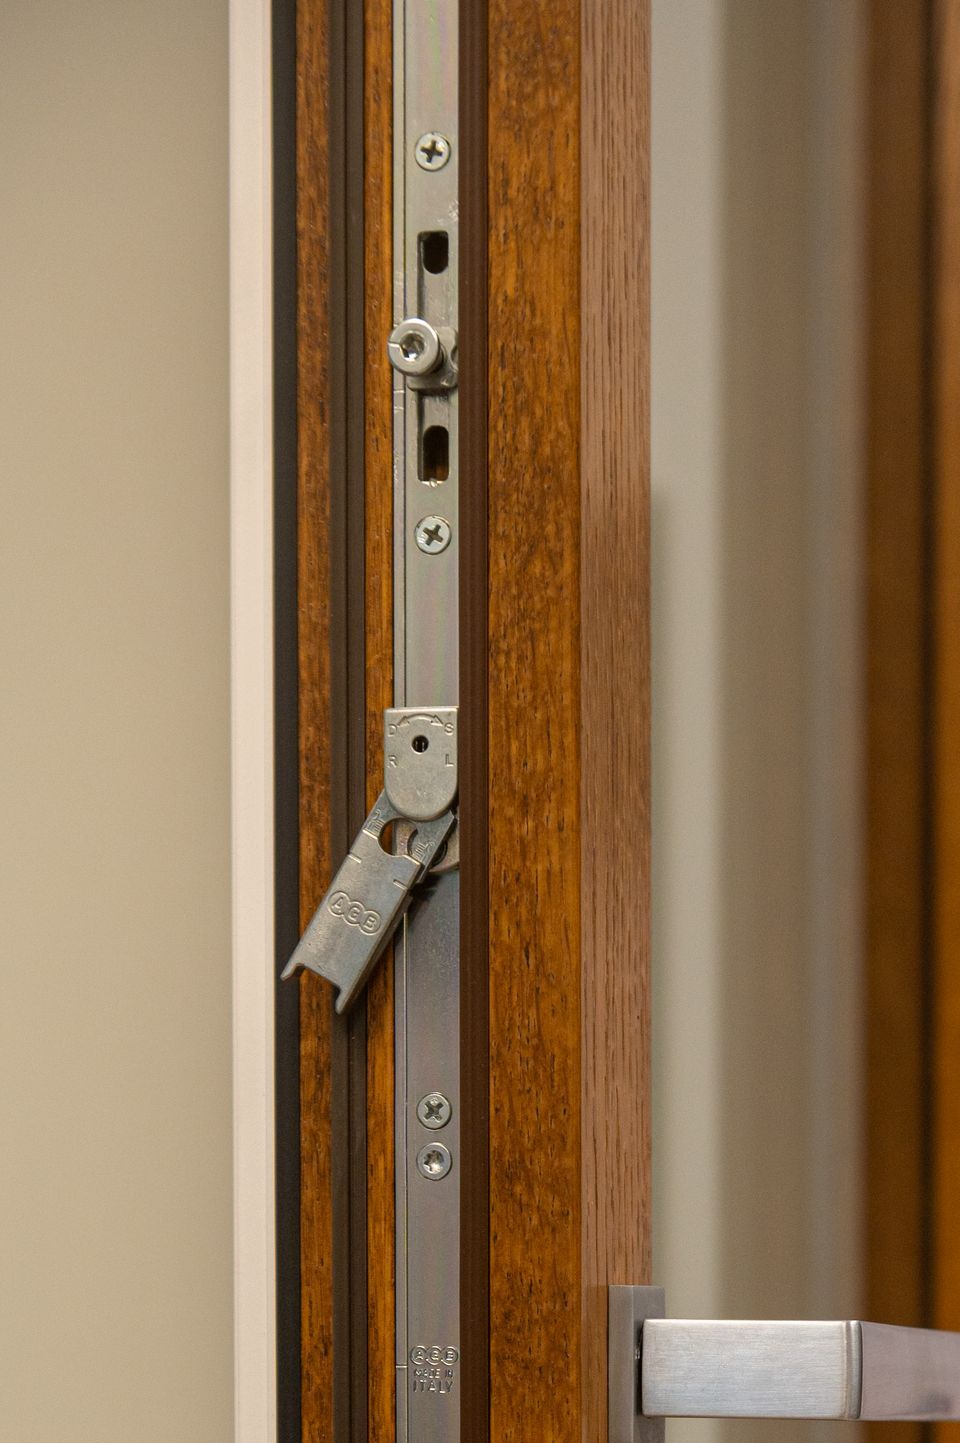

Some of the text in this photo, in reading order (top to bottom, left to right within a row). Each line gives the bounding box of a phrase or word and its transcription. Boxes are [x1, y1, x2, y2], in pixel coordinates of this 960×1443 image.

[387, 723, 398, 737] D
[444, 722, 455, 736] S
[387, 754, 398, 768] R
[444, 753, 455, 768] L
[328, 890, 381, 936] AGB
[411, 1345, 459, 1365] AGB
[413, 1368, 441, 1379] MADE
[413, 1379, 455, 1393] ITALY
